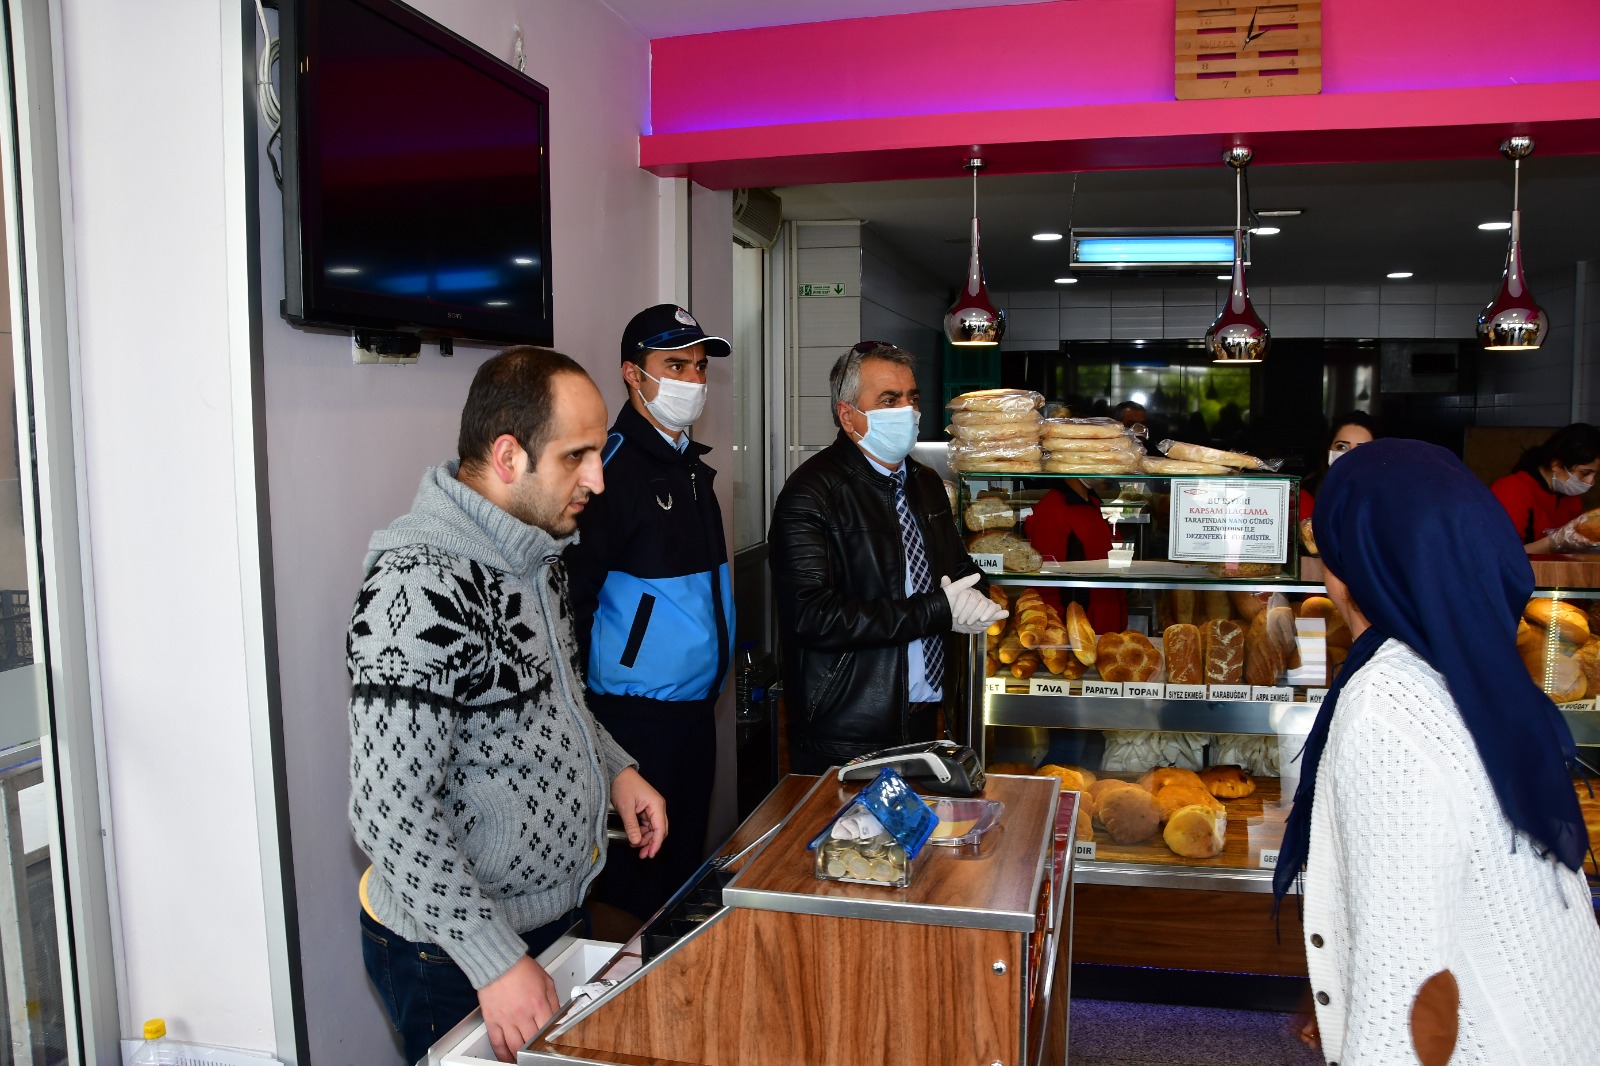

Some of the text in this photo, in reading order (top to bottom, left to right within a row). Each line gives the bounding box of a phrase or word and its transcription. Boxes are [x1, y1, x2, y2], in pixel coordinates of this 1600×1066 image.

[1289, 14, 1296, 22] 2
[1302, 34, 1310, 43] 3
[1201, 63, 1209, 71] 8
[1288, 58, 1296, 67] 4
[1222, 80, 1229, 89] 7
[1266, 79, 1274, 87] 5
[1243, 86, 1251, 94] 6
[1189, 507, 1223, 515] KAPSAM
[1249, 517, 1274, 526] GÜMÜŞ
[1036, 684, 1063, 694] TAVA
[1085, 685, 1119, 696] PAPATYA
[1128, 687, 1159, 697] TOPAN
[1212, 689, 1248, 699] KARABUĞDAY
[1255, 693, 1269, 702] ARPA
